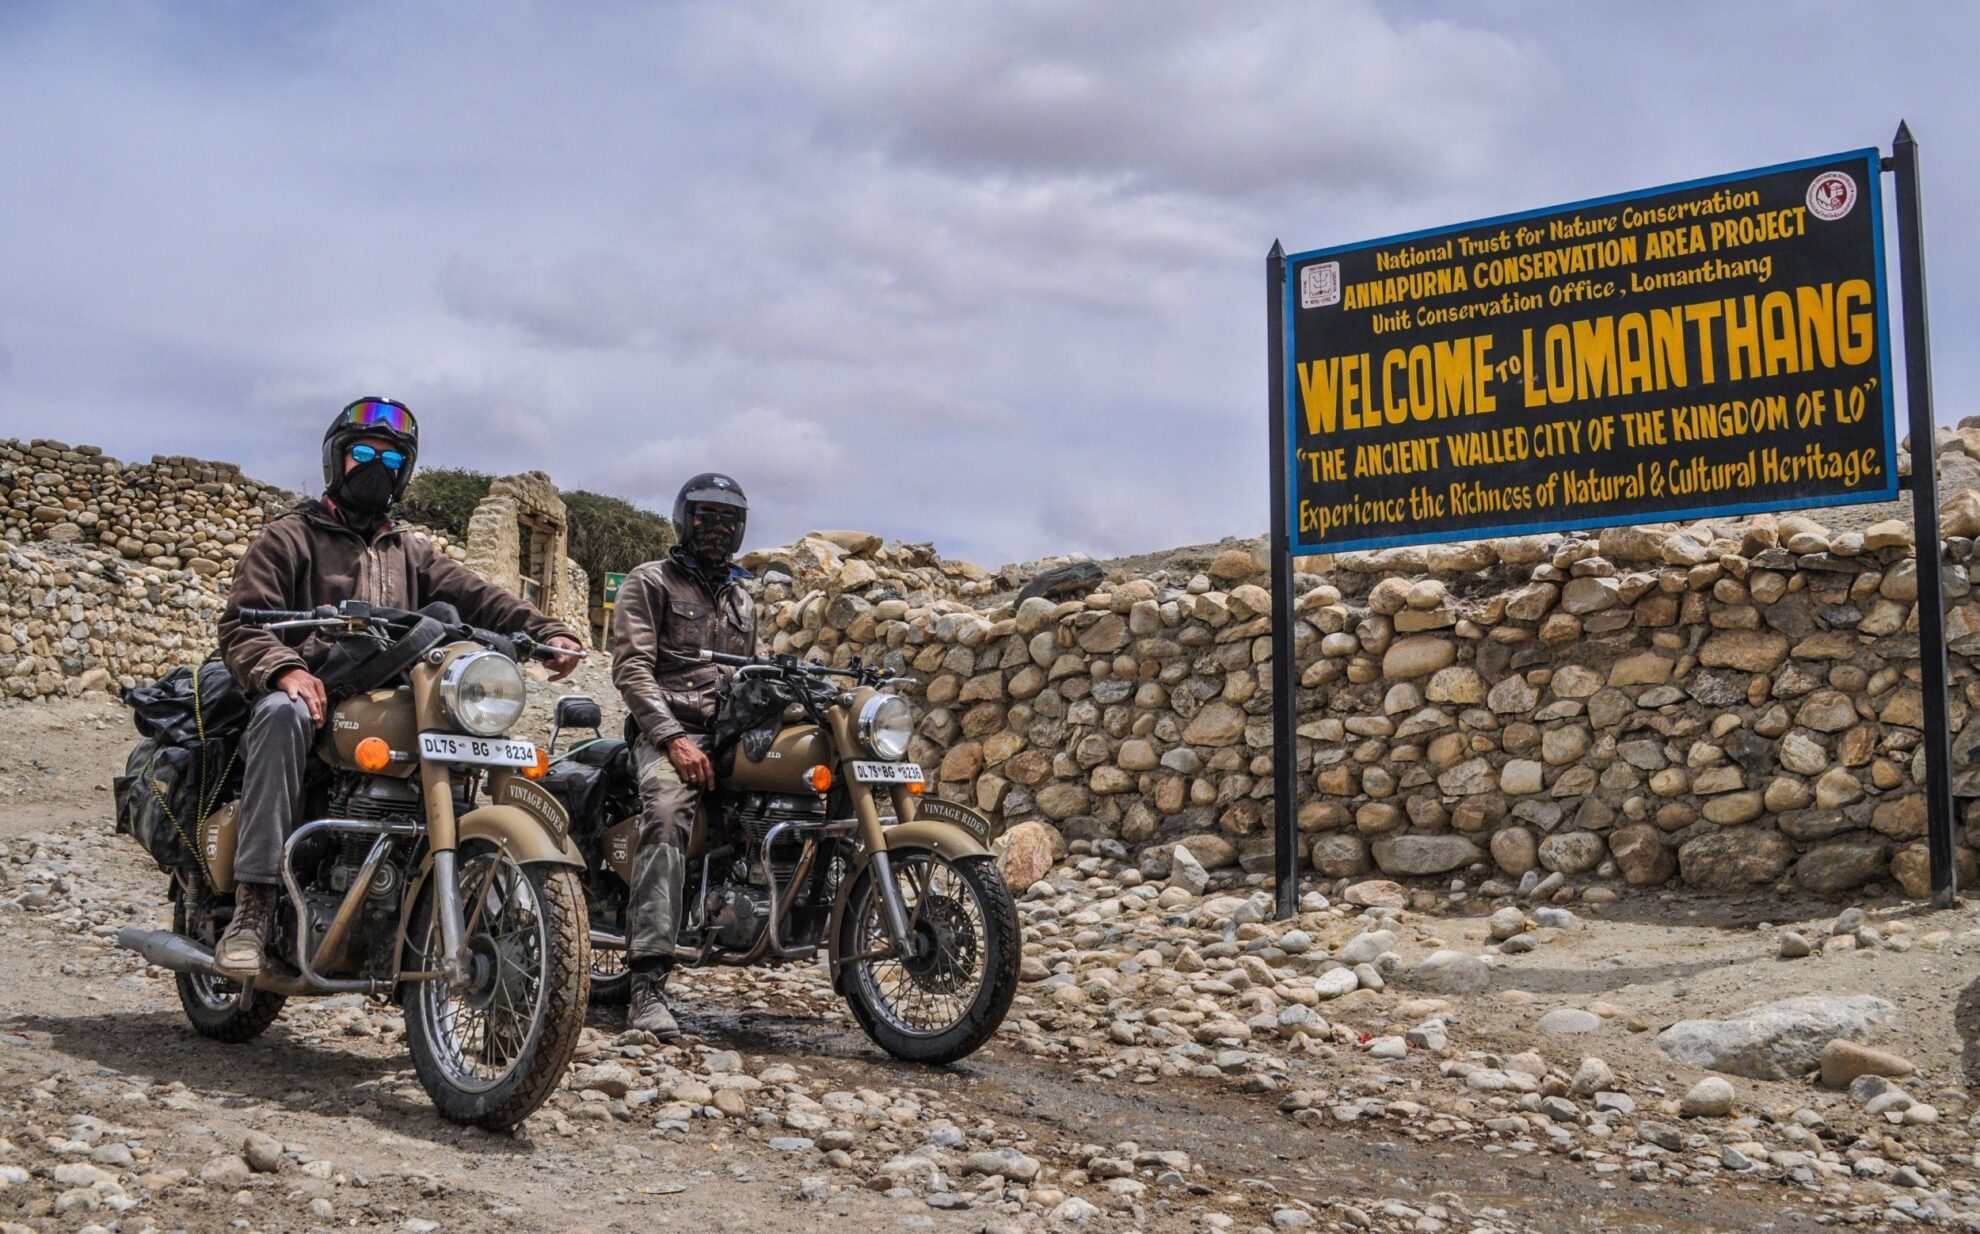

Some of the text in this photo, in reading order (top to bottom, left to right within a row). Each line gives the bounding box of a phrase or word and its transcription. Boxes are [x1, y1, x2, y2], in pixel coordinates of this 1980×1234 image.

[1343, 265, 1469, 311] ANNAPURNA
[1473, 235, 1638, 290] CONSERVATION
[1644, 224, 1707, 261] AREA
[1710, 206, 1807, 251] PROJECT
[1376, 189, 1760, 272] National Trust for Nature Conservation
[1372, 310, 1412, 335] Unit
[1417, 292, 1543, 327] Conservation
[1631, 255, 1772, 293] Lomanthang
[1297, 334, 1497, 436] WELCOME
[1522, 279, 1874, 408] LOMANTHANG
[1353, 436, 1441, 479] ANCIENT
[1446, 426, 1530, 467] WALLED
[1533, 419, 1583, 460] CITY
[1587, 415, 1615, 453] OF
[1620, 409, 1668, 448] THE
[1671, 395, 1789, 442] KINGDOM
[1795, 389, 1827, 429] OF
[1299, 442, 1882, 538] Experience the Richness of Natural & Cultural Heritage.
[424, 738, 534, 761] DL7S BG 8234
[881, 765, 895, 778] BG
[902, 766, 921, 779] 8236
[510, 785, 564, 833] VINTAGE RIDES
[924, 803, 986, 836] VINTAGE RIDES
